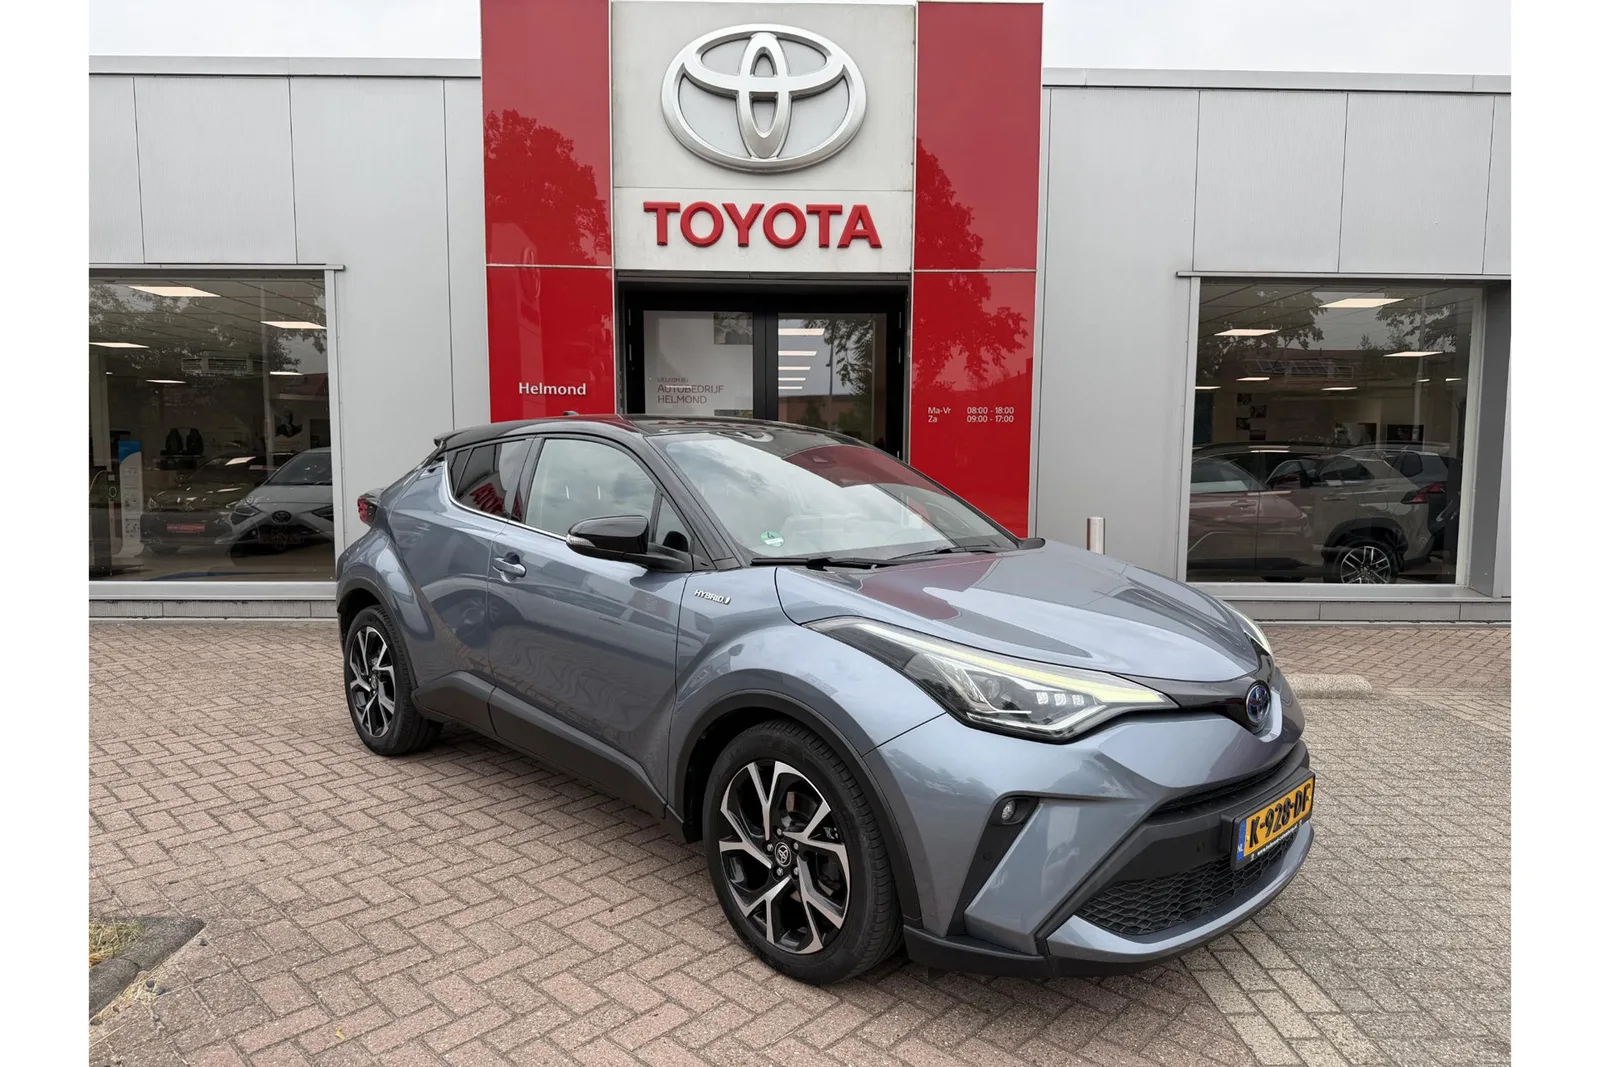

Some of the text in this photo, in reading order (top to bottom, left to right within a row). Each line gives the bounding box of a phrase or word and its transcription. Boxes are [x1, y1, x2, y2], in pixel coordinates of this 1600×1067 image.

[643, 201, 882, 248] TOYOTA
[518, 382, 587, 396] Helmond
[657, 384, 724, 393] AUTOBEDRIJF
[657, 395, 707, 404] HELMOND
[927, 406, 951, 414] Ma-Vr
[966, 406, 988, 414] 08:00
[995, 406, 1015, 414] 18:00
[694, 589, 724, 603] HYBRID
[1249, 783, 1311, 848] K-928-DF
